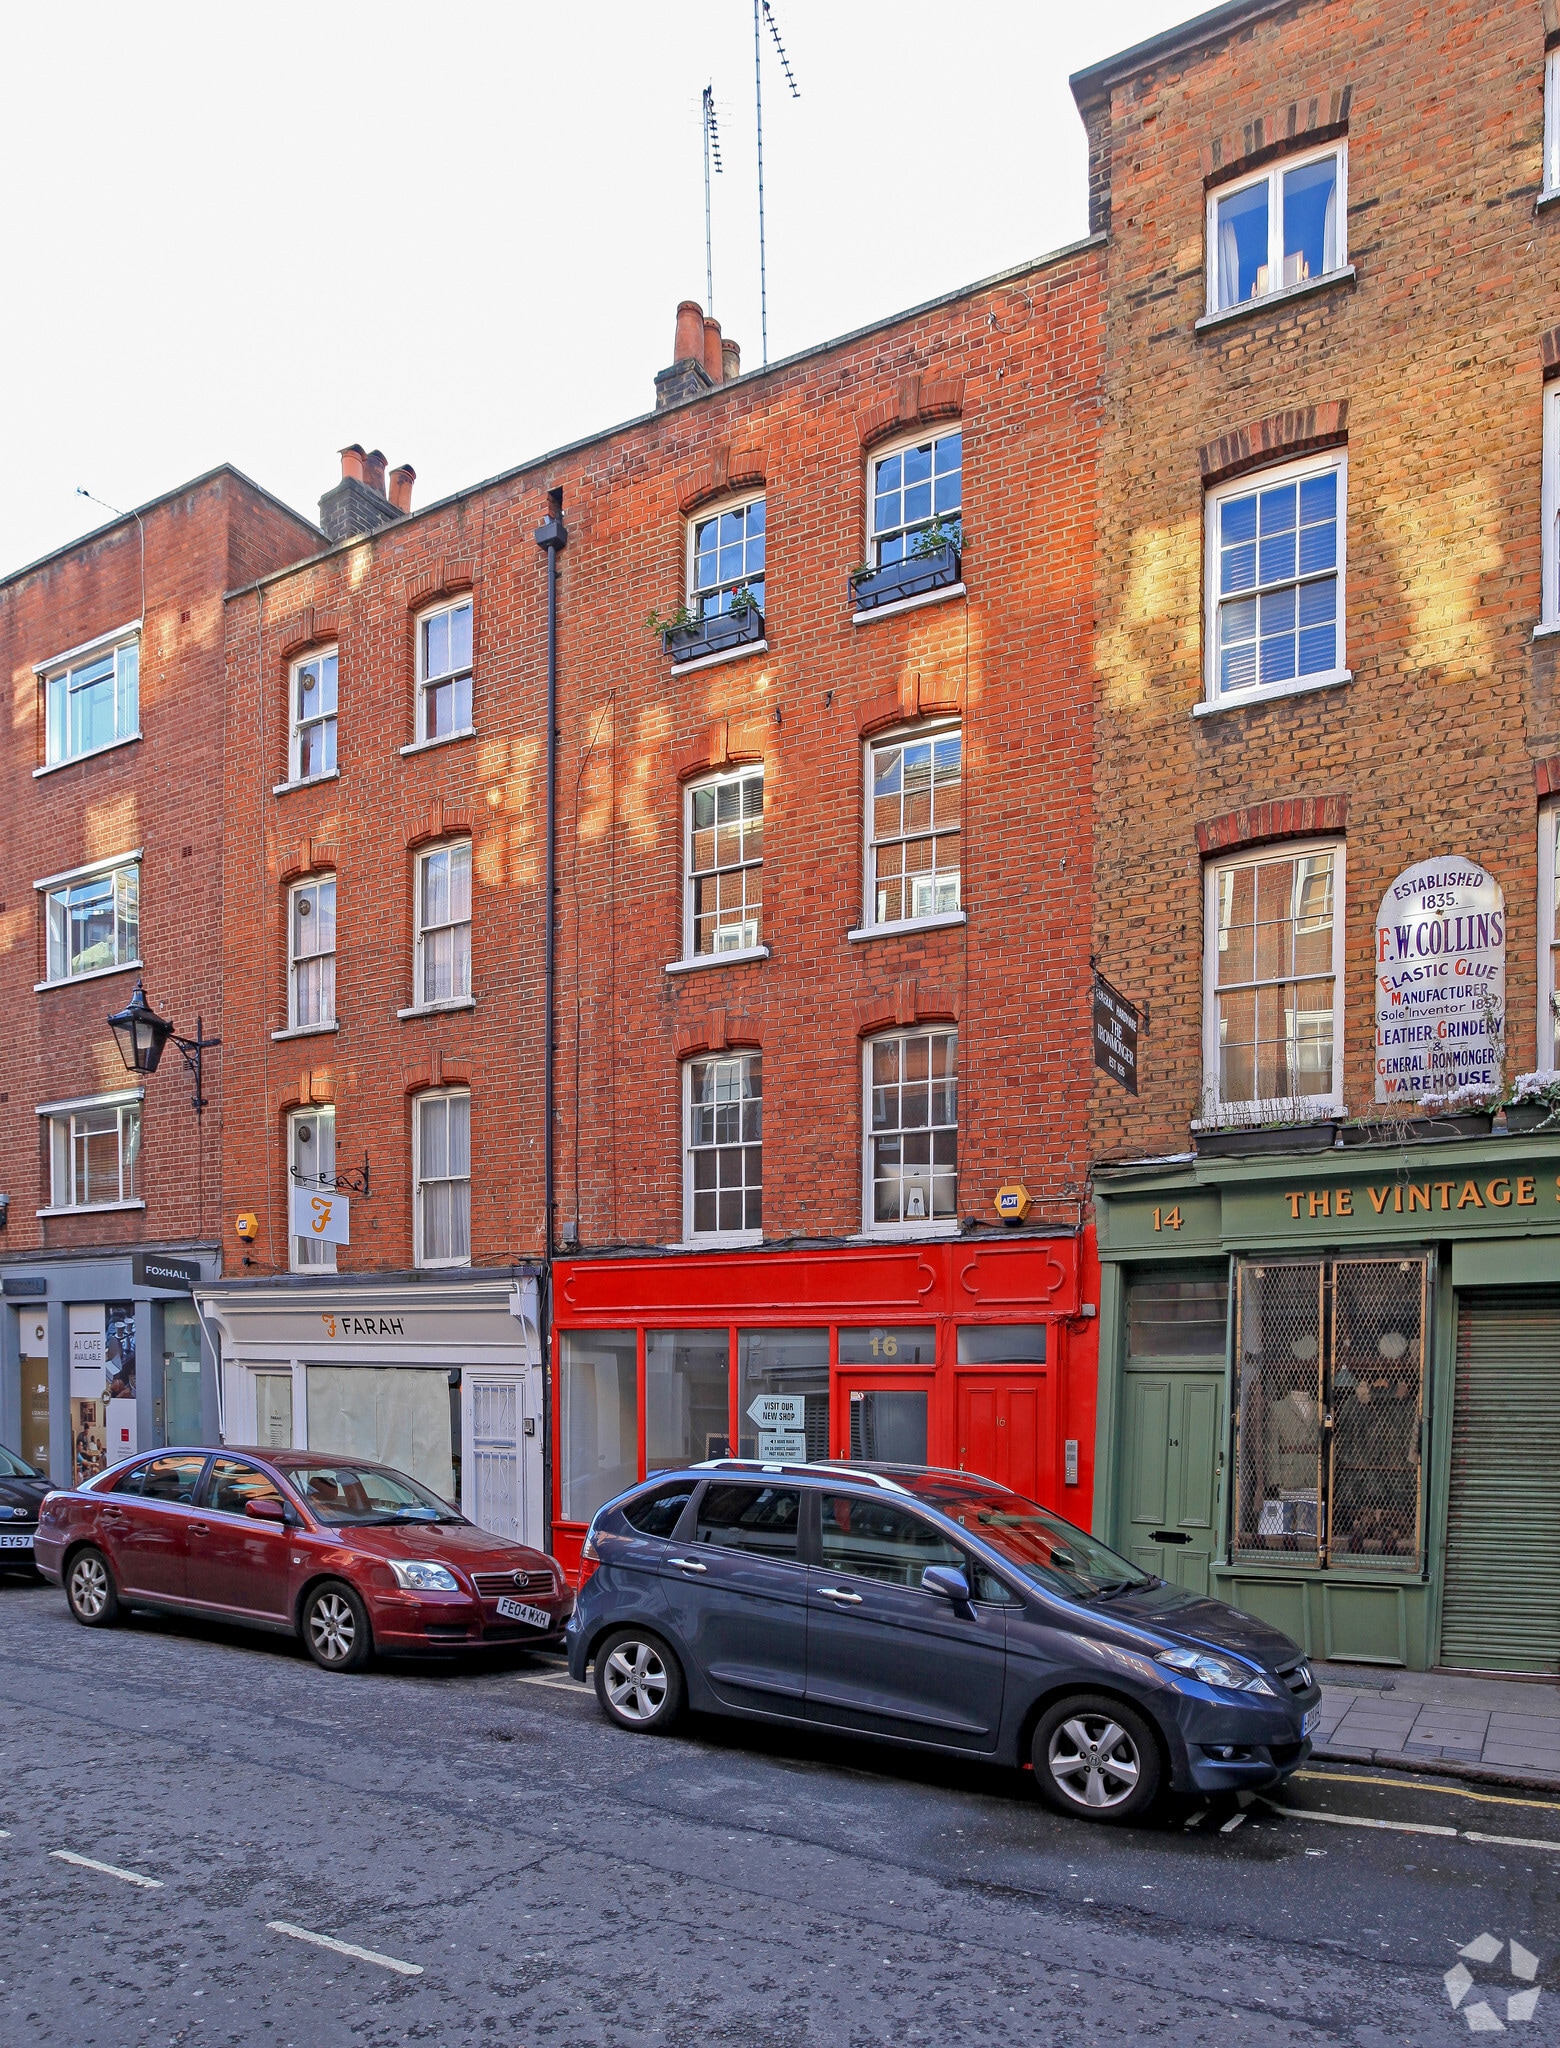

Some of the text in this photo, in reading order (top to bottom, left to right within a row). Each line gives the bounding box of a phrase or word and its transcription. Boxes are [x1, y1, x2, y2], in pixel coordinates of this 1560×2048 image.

[1393, 872, 1484, 901] ESTABLISHED
[1421, 892, 1459, 910] 1835.
[1379, 958, 1499, 994] ELASTIC GLUE
[1391, 982, 1489, 1007] MANUFACTURER
[1376, 1009, 1405, 1022] (Sole
[1409, 1003, 1466, 1018] Inventor
[1110, 1018, 1123, 1041] THE
[1437, 1017, 1503, 1039] GRINDERY
[1097, 1023, 1135, 1068] IRONMONGER
[1432, 1042, 1444, 1052] &
[1377, 1055, 1425, 1075] GENERAL
[1001, 1196, 1018, 1206] ADT
[1285, 1188, 1354, 1218] THE
[1367, 1176, 1537, 1213] VINTAGE
[1151, 1206, 1185, 1231] 14
[145, 1265, 191, 1280] FOXHALL
[341, 1317, 404, 1336] FARAH
[83, 1340, 101, 1350] CAFE
[869, 1335, 898, 1357] 16
[74, 1352, 101, 1361] AVAILABLE
[762, 1411, 796, 1421] NEW SHOP
[764, 1402, 794, 1411] VISIT OUR
[996, 1415, 1006, 1427] 16
[1169, 1438, 1179, 1447] 14
[1, 1536, 30, 1546] EY57
[501, 1599, 547, 1625] FE04 MXH
